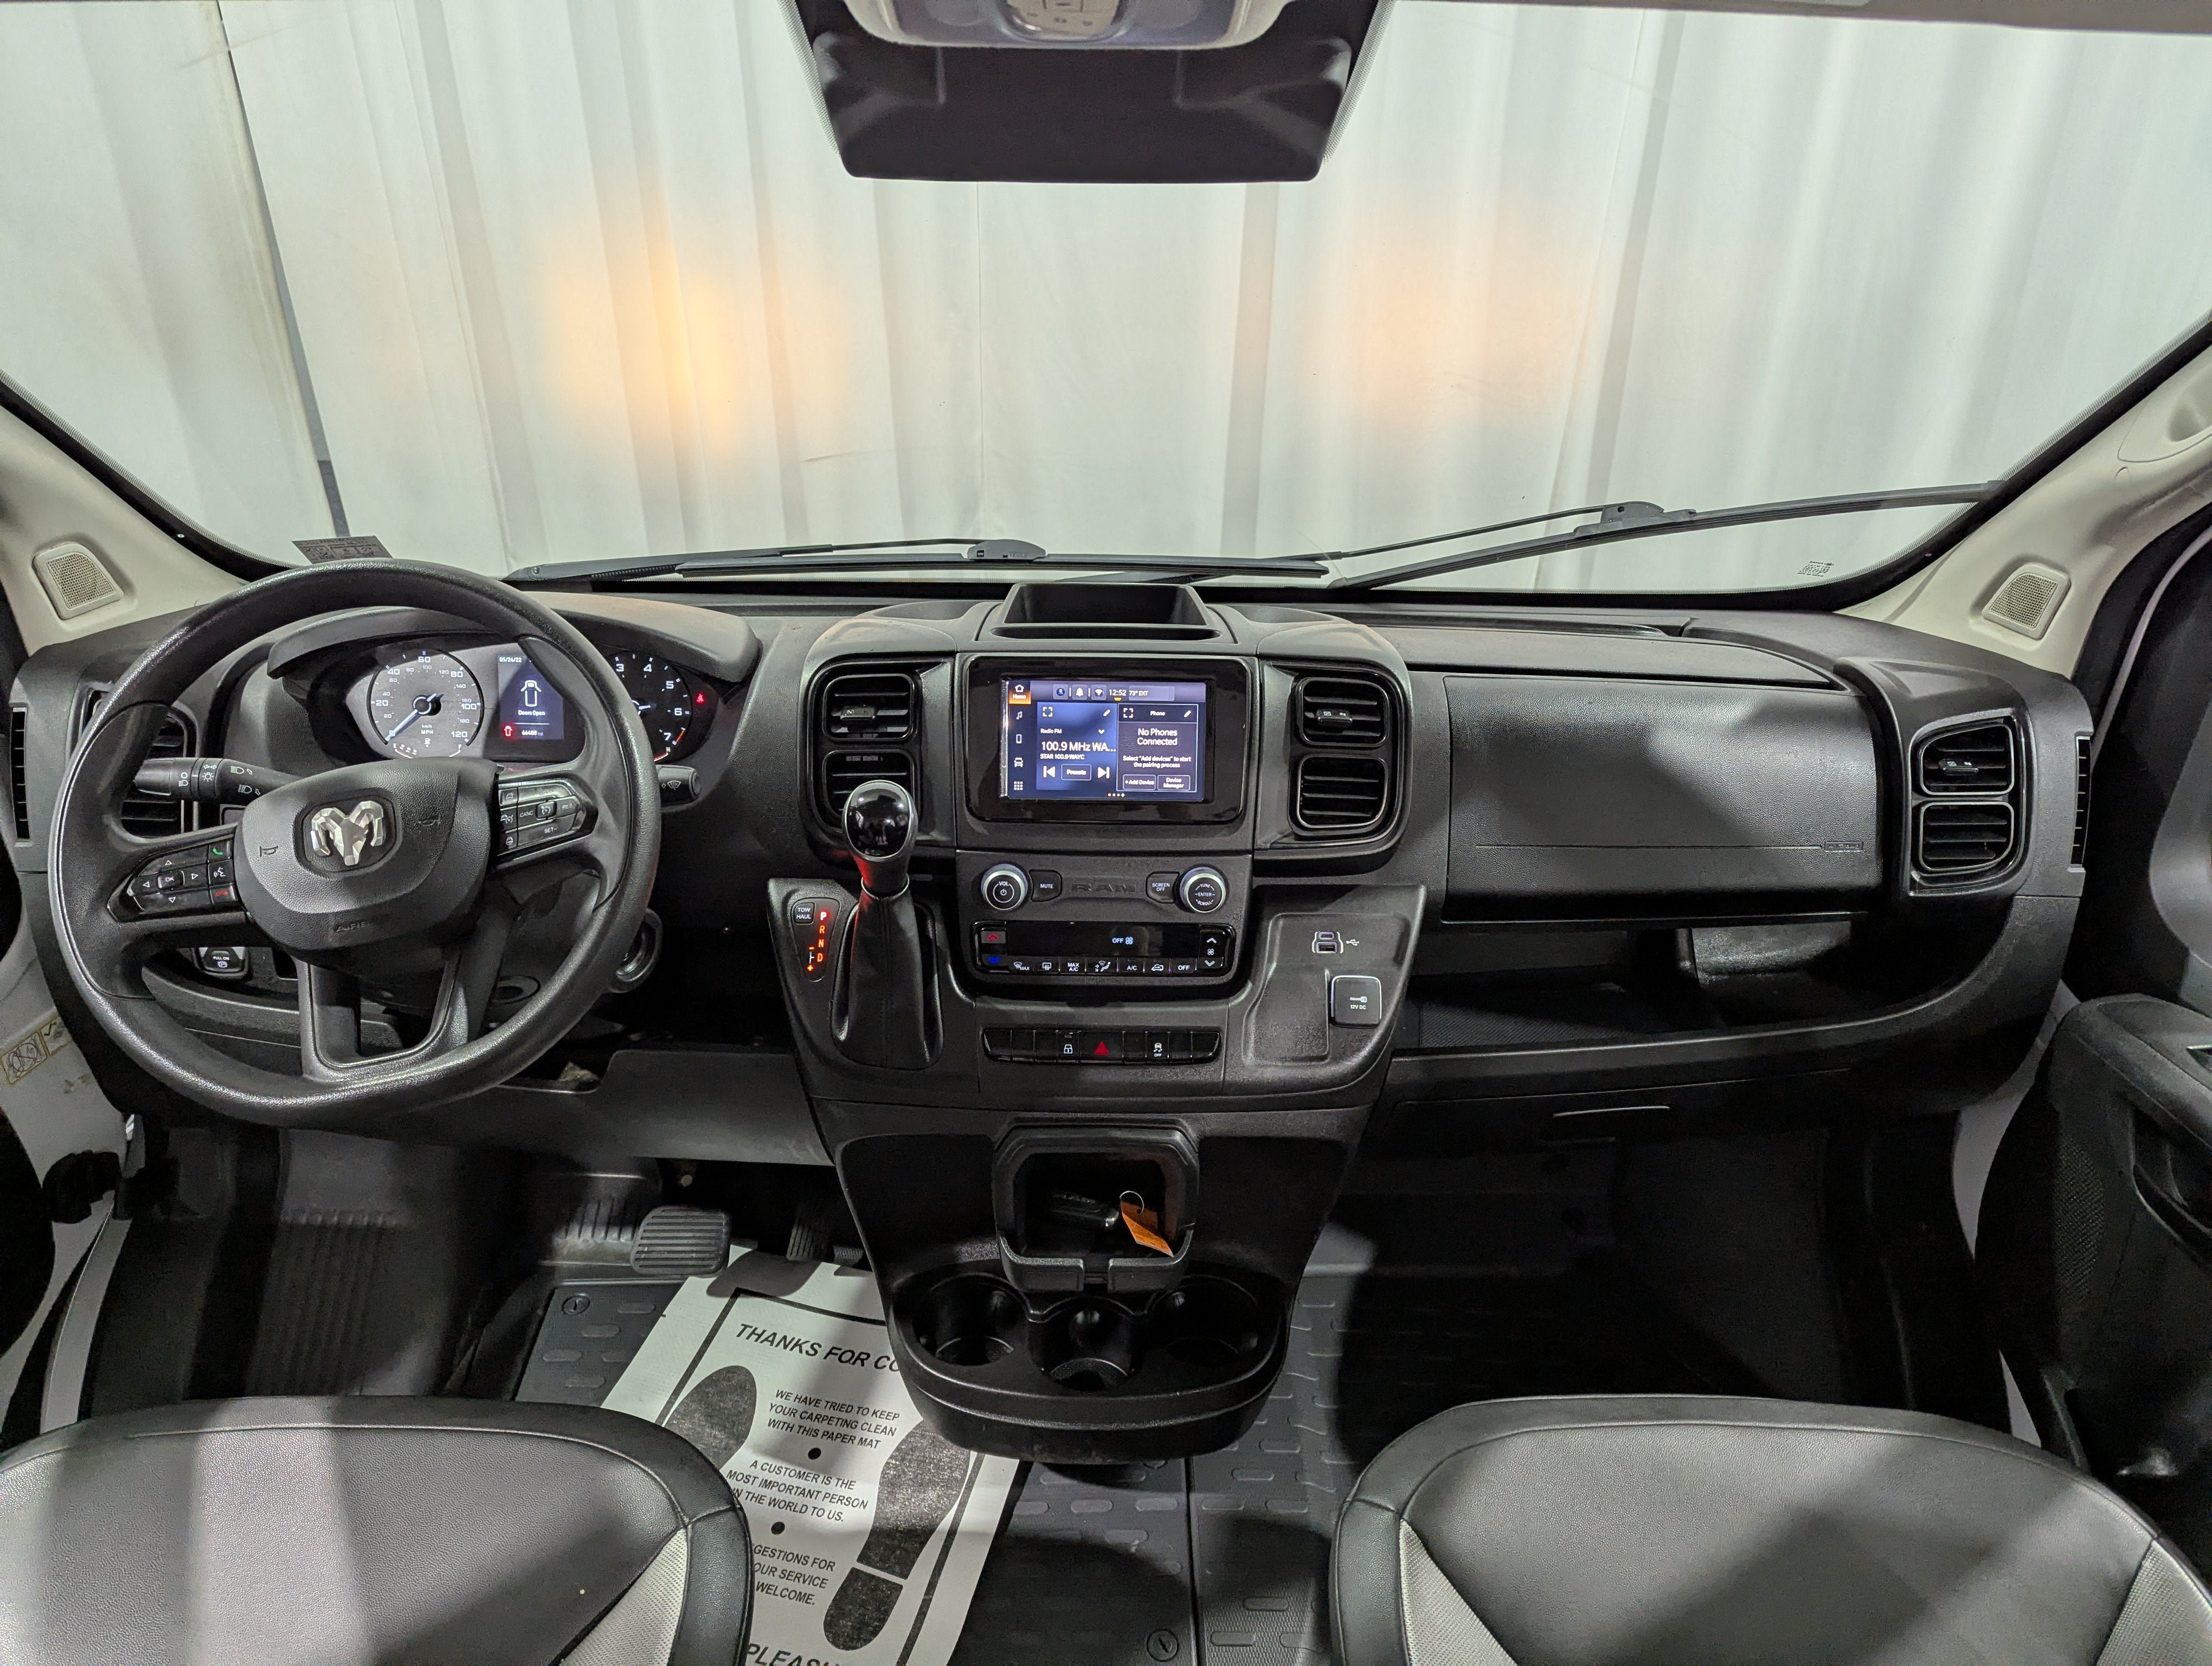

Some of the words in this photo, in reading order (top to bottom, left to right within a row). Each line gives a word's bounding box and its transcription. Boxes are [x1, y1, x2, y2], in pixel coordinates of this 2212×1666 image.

[616, 663, 624, 672] 3
[643, 664, 652, 672] 4
[666, 681, 674, 689] 5
[674, 708, 682, 716] 6
[664, 732, 672, 741] 7
[1137, 728, 1149, 736] No
[1150, 728, 1178, 736] Phones
[1041, 741, 1068, 751] 100.9
[1069, 741, 1091, 752] MHz
[1137, 737, 1178, 746] Connected
[820, 912, 827, 921] P
[819, 925, 825, 934] R
[818, 939, 824, 948] N
[817, 953, 823, 962] D
[736, 1323, 822, 1356] THANKS
[823, 1346, 871, 1367] FOR
[775, 1389, 794, 1401] WE
[794, 1394, 822, 1408] HAVE
[824, 1400, 854, 1413] TRIED
[856, 1406, 870, 1415] TO
[871, 1409, 900, 1421] KEEP
[769, 1402, 799, 1418] YOUR
[799, 1411, 858, 1430] CARPETING
[860, 1422, 897, 1437] CLEAN
[767, 1418, 795, 1432] WITH
[796, 1425, 820, 1438] THIS
[821, 1430, 857, 1445] PAPER
[857, 1437, 881, 1449] MAT
[750, 1460, 758, 1469] A
[760, 1462, 820, 1484] CUSTOMER
[821, 1475, 833, 1485] IS
[835, 1478, 857, 1490] THE
[726, 1470, 759, 1484] MOST
[758, 1478, 822, 1501] IMPORTANT
[822, 1492, 869, 1510] PERSON
[745, 1491, 767, 1505] THE
[768, 1497, 808, 1514] WORLD
[811, 1506, 826, 1518] TO
[827, 1510, 844, 1522] US.
[754, 1543, 810, 1566] GESTIONS
[811, 1558, 836, 1572] FOR
[753, 1562, 778, 1577] OUR
[779, 1568, 828, 1589] SERVICE
[756, 1581, 815, 1605] WELCOME.
[748, 1643, 838, 1666] PLEA
